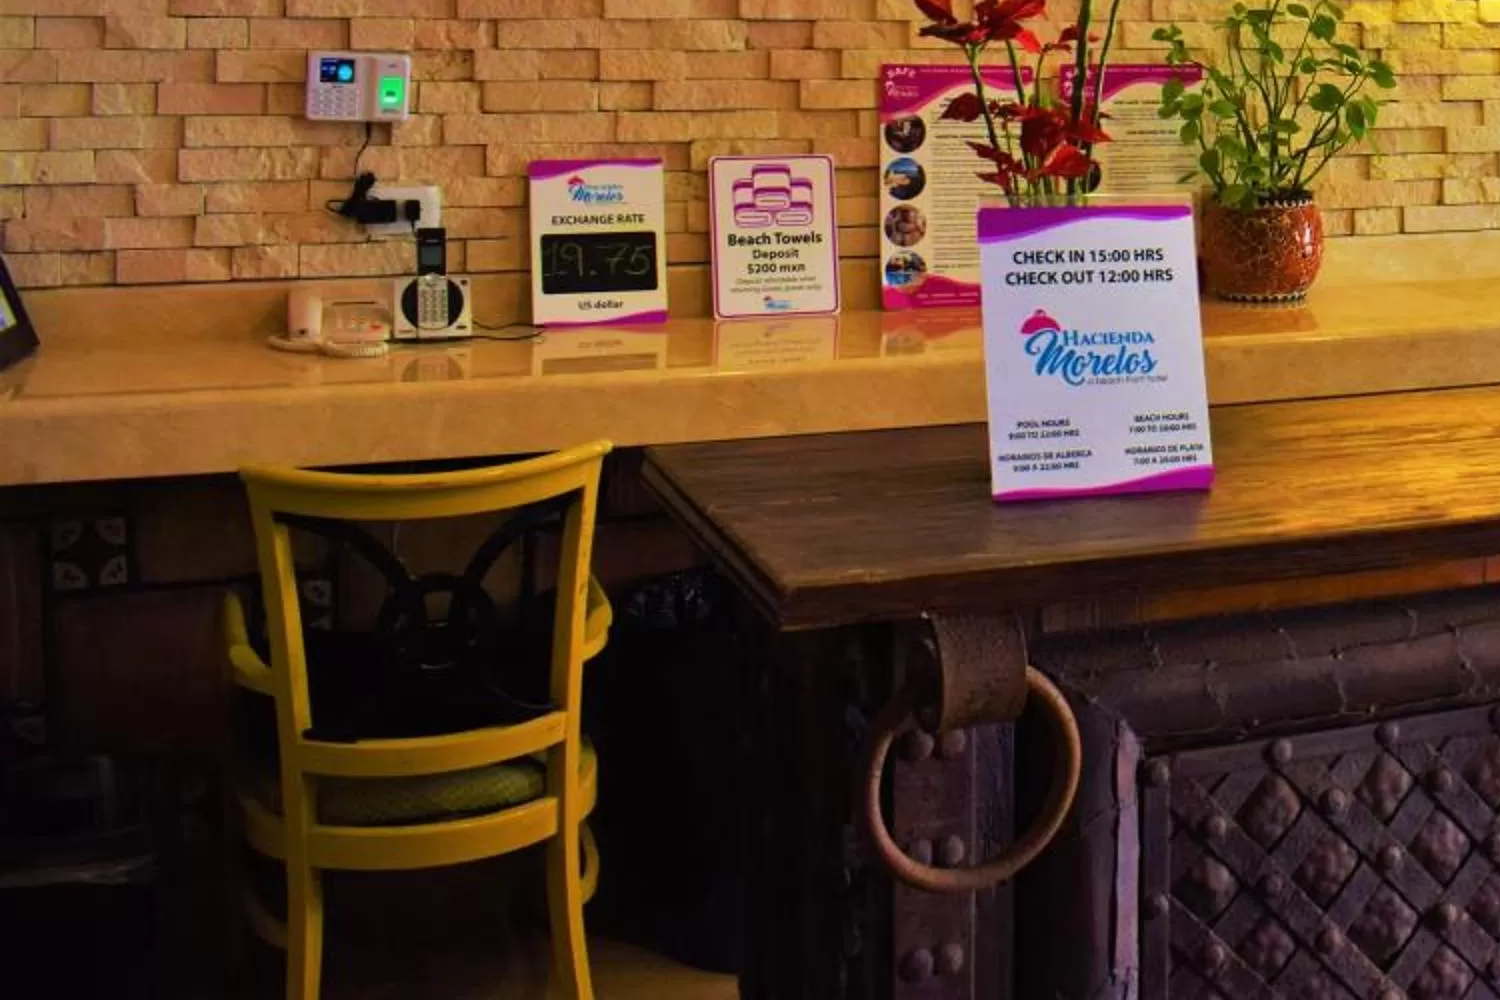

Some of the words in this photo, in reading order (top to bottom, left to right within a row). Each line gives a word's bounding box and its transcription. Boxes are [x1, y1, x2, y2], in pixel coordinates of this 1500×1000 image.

[551, 215, 614, 226] EXCHANGE
[617, 213, 645, 223] RATE
[727, 232, 771, 246] Beach
[773, 231, 823, 244] Towels
[543, 240, 653, 278] 19.75
[752, 248, 799, 260] Deposit
[1013, 250, 1065, 264] CHECK
[1069, 250, 1085, 263] IN
[1089, 249, 1130, 263] 15:00
[1133, 248, 1164, 262] HRS
[1005, 271, 1058, 285] CHECK
[1061, 270, 1094, 284] OUT
[1100, 270, 1140, 283] 12:00
[1143, 269, 1173, 282] HRS
[1062, 330, 1155, 346] HACIENDA
[1025, 329, 1158, 386] Morelos
